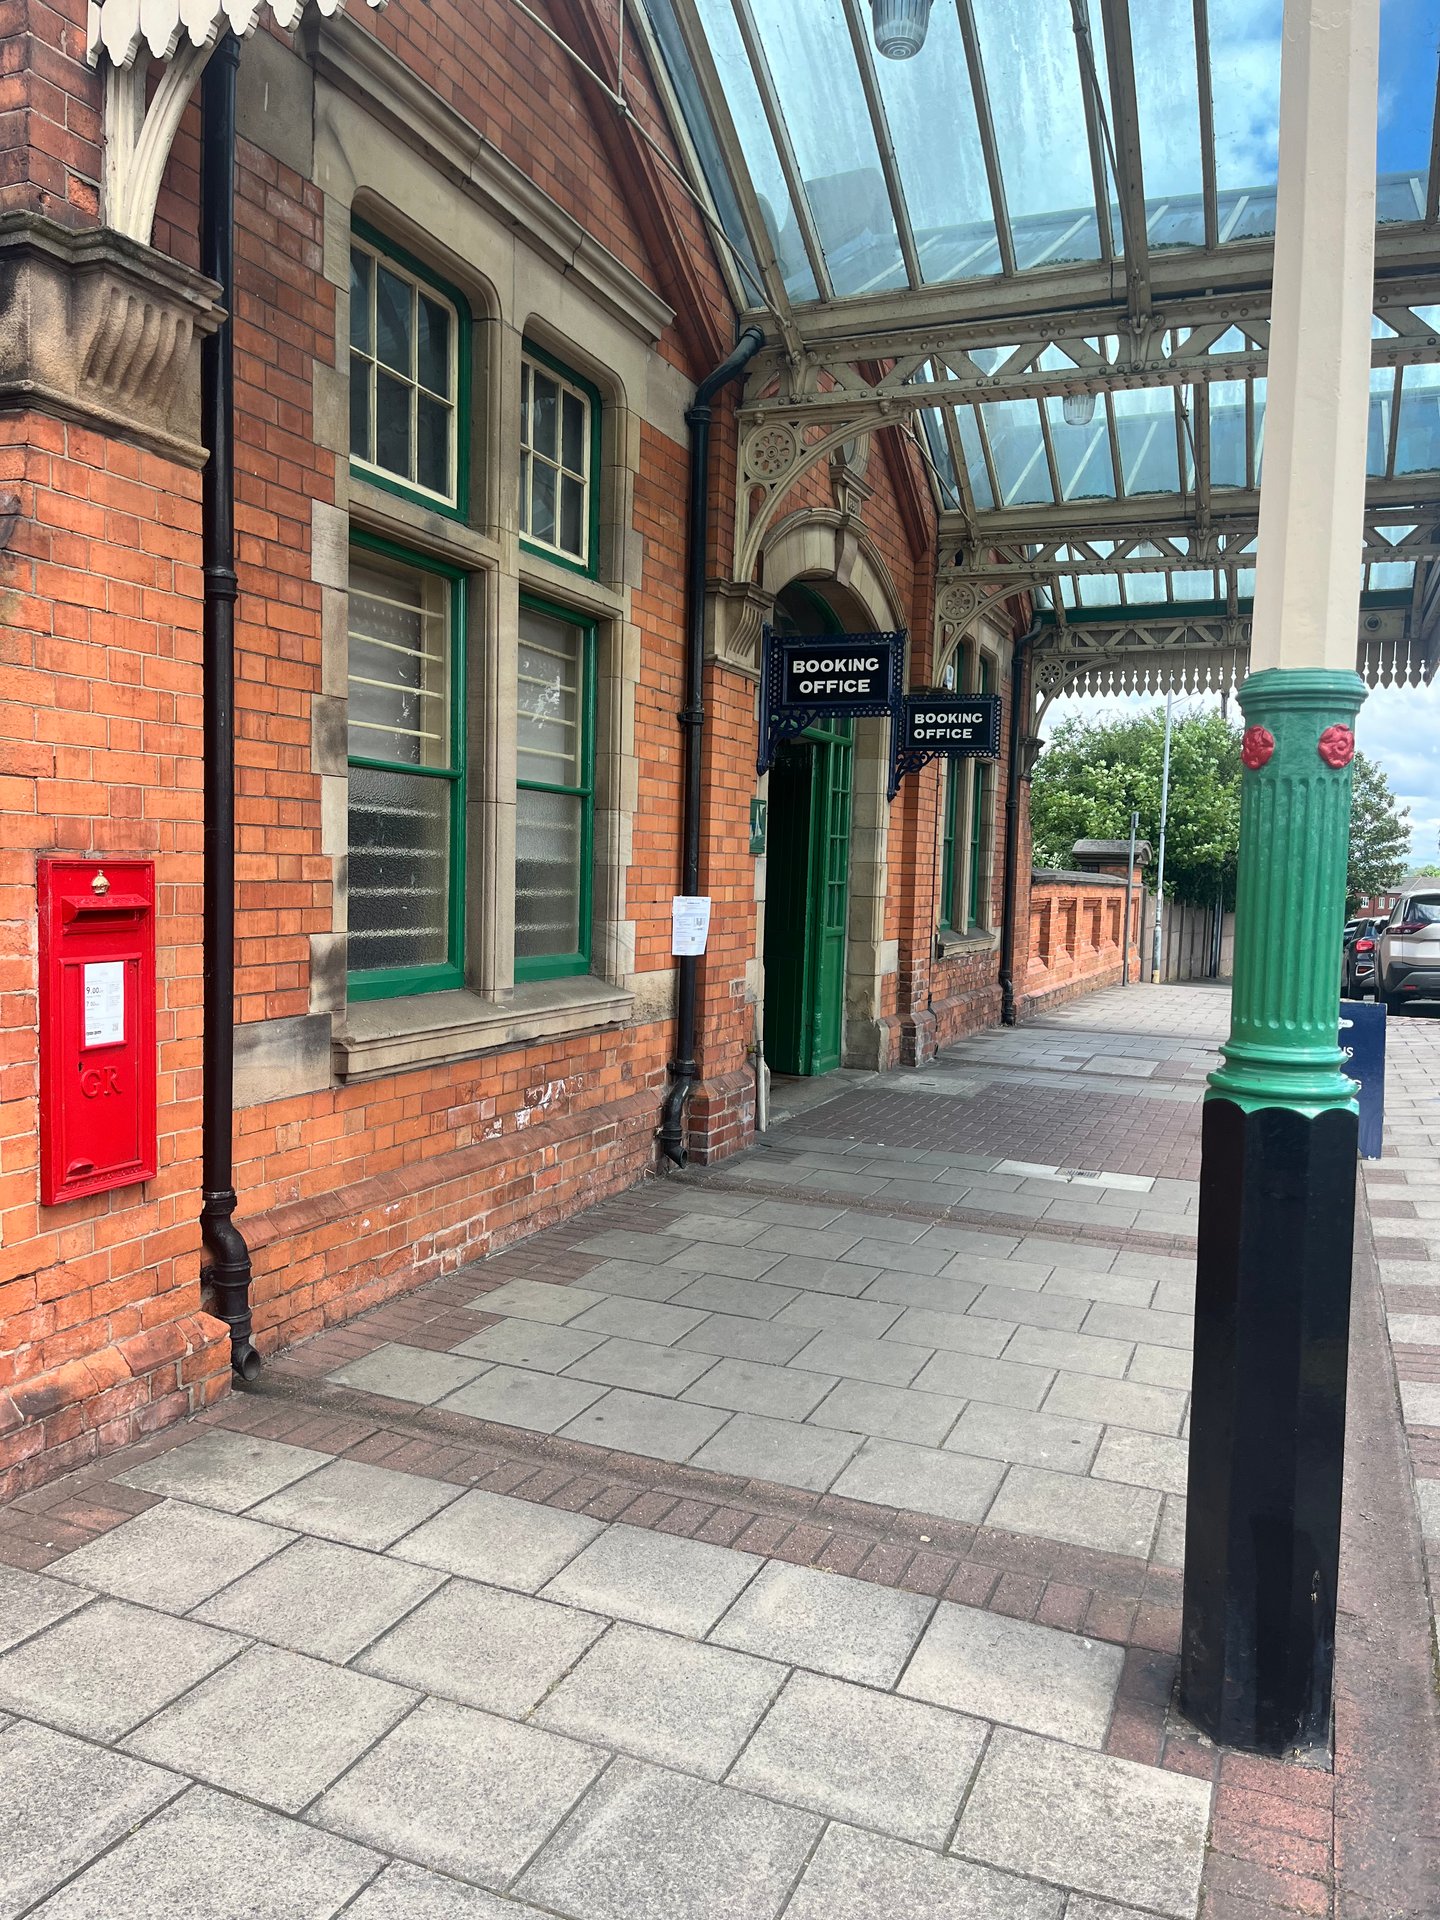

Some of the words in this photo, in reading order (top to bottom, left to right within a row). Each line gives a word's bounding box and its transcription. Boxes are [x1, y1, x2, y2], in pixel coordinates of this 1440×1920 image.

[793, 658, 879, 673] BOOKING
[799, 679, 871, 694] OFFICE
[914, 713, 983, 724] BOOKING
[913, 728, 973, 739] OFFICE
[80, 1066, 122, 1099] GR
